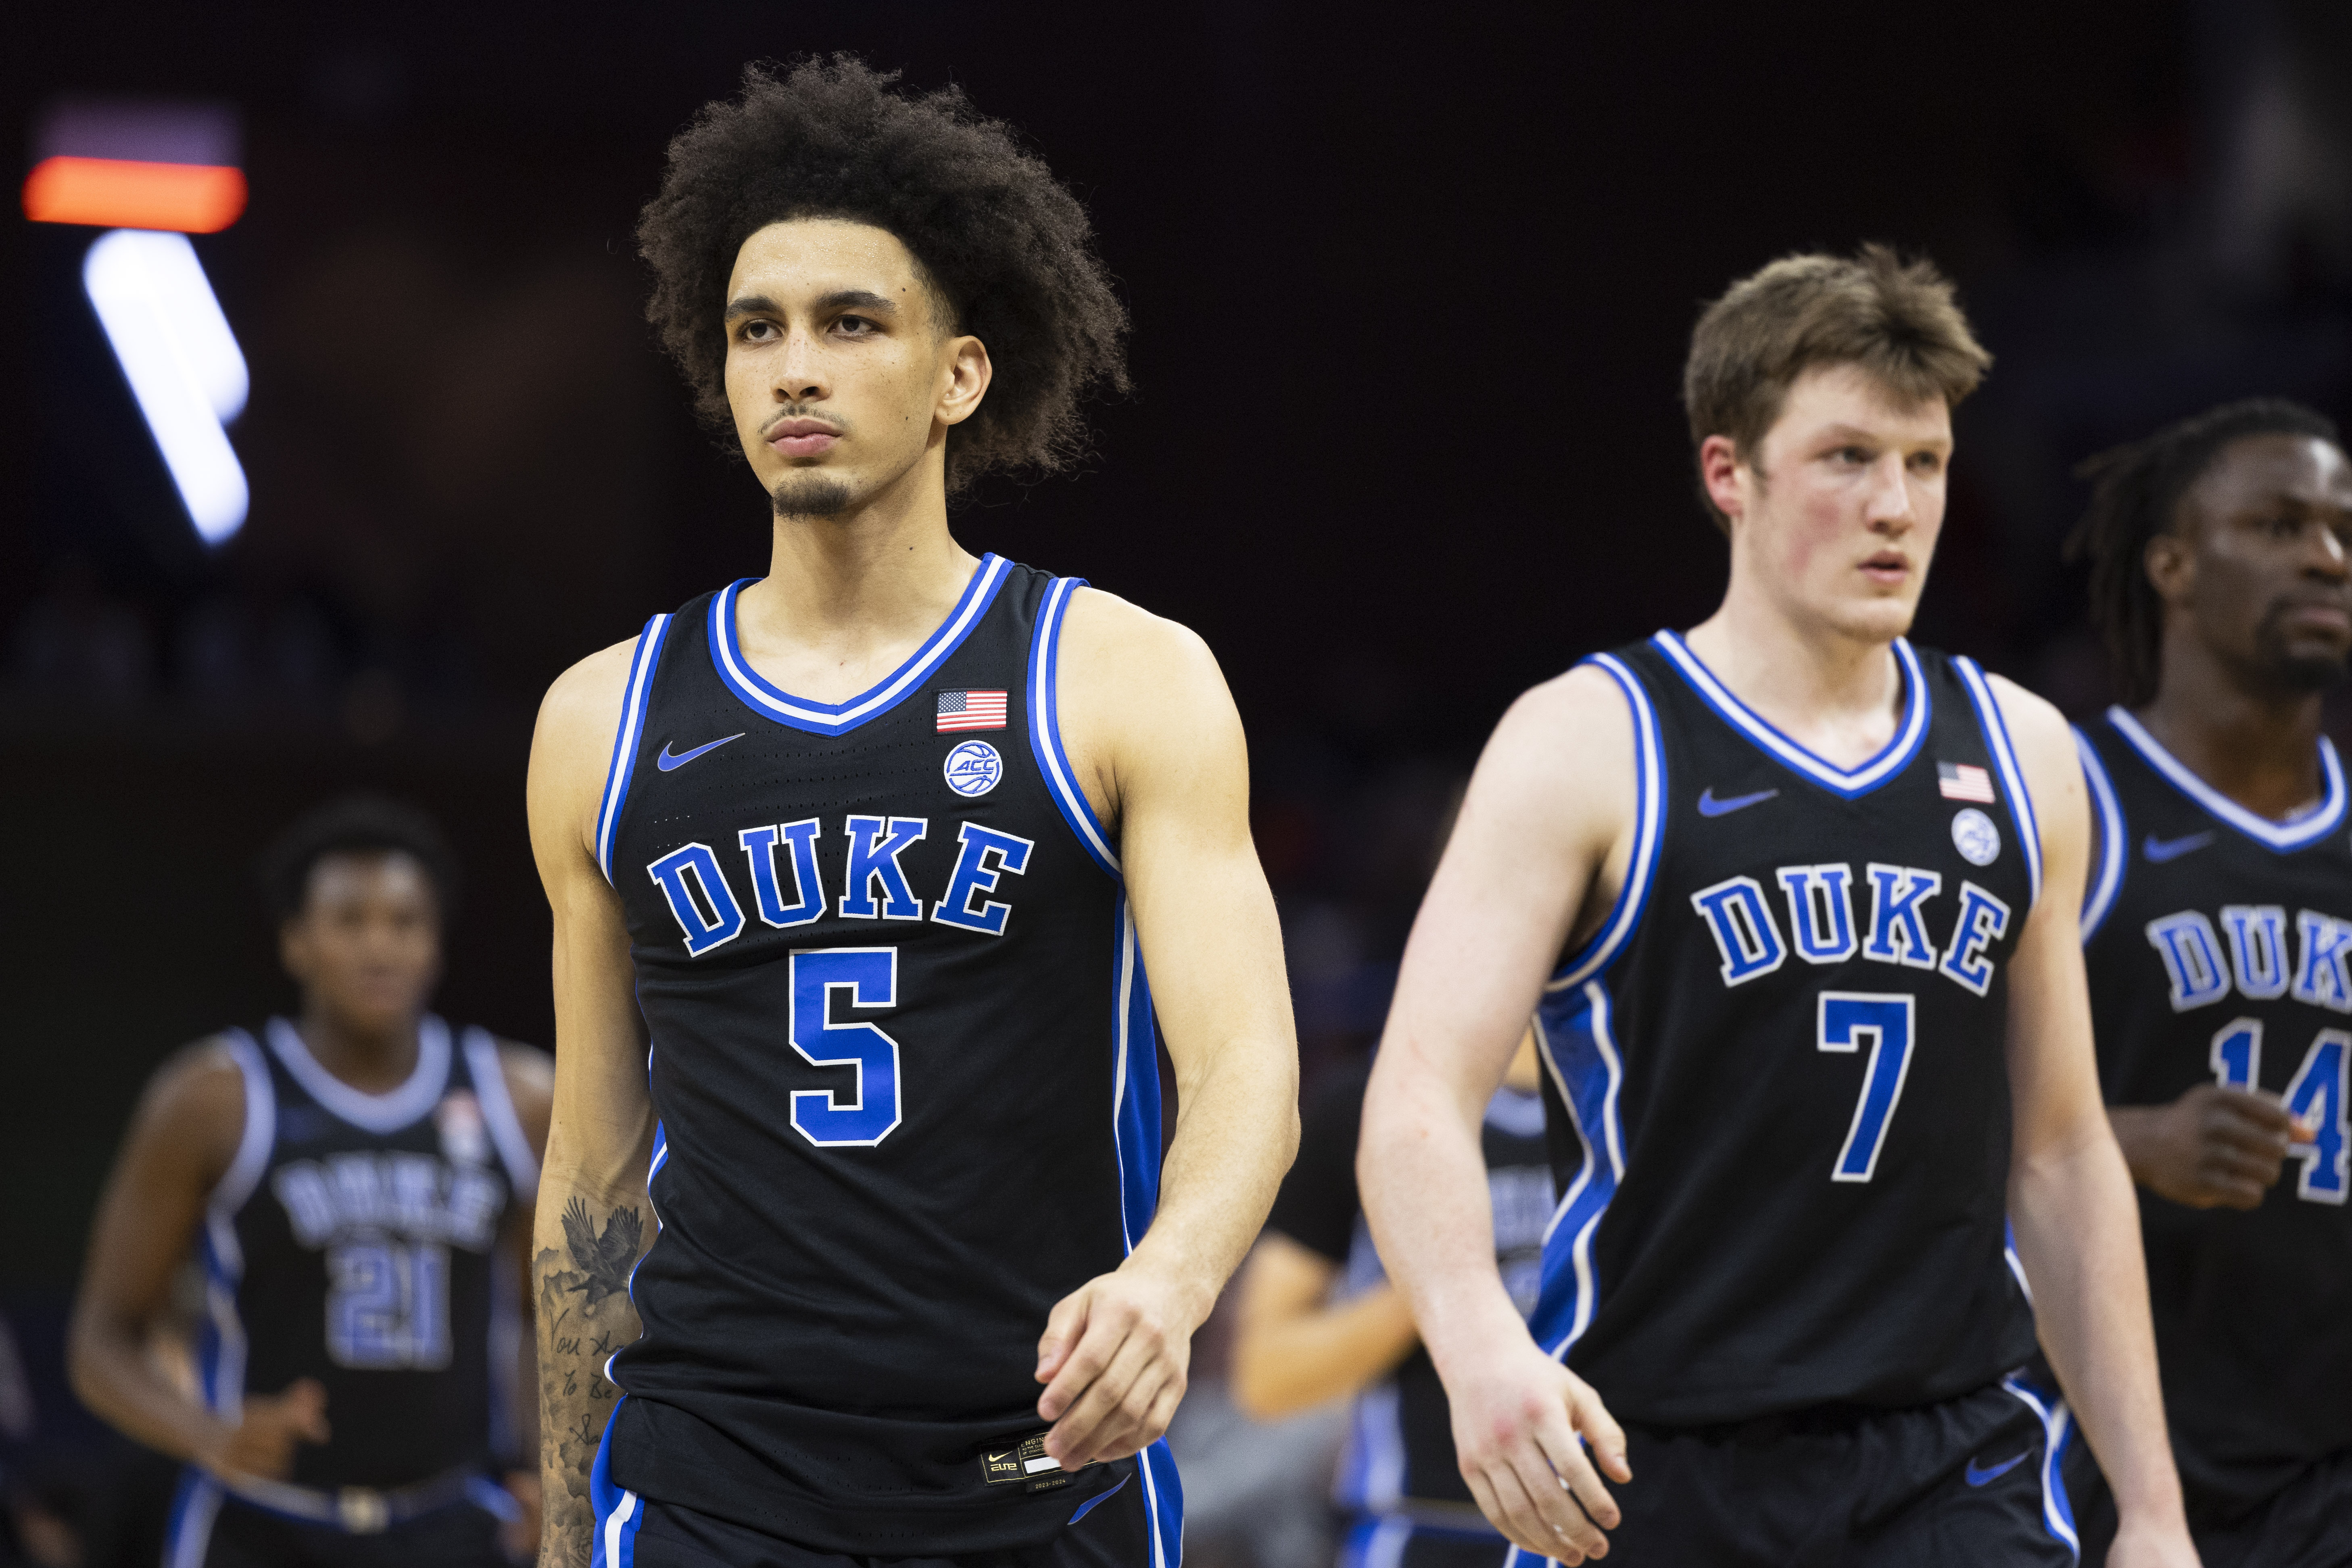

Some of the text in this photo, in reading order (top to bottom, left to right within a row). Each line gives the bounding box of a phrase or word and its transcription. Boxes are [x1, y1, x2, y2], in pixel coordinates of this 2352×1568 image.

[953, 758, 998, 772] ACC
[647, 815, 1035, 958] DUKE
[1690, 862, 2011, 997] DUKE
[789, 946, 902, 1147] 5
[1817, 991, 1915, 1183] 7
[325, 1242, 453, 1370] 21
[1021, 1437, 1044, 1447] ENGIN
[1035, 1478, 1066, 1489] 2023-2024
